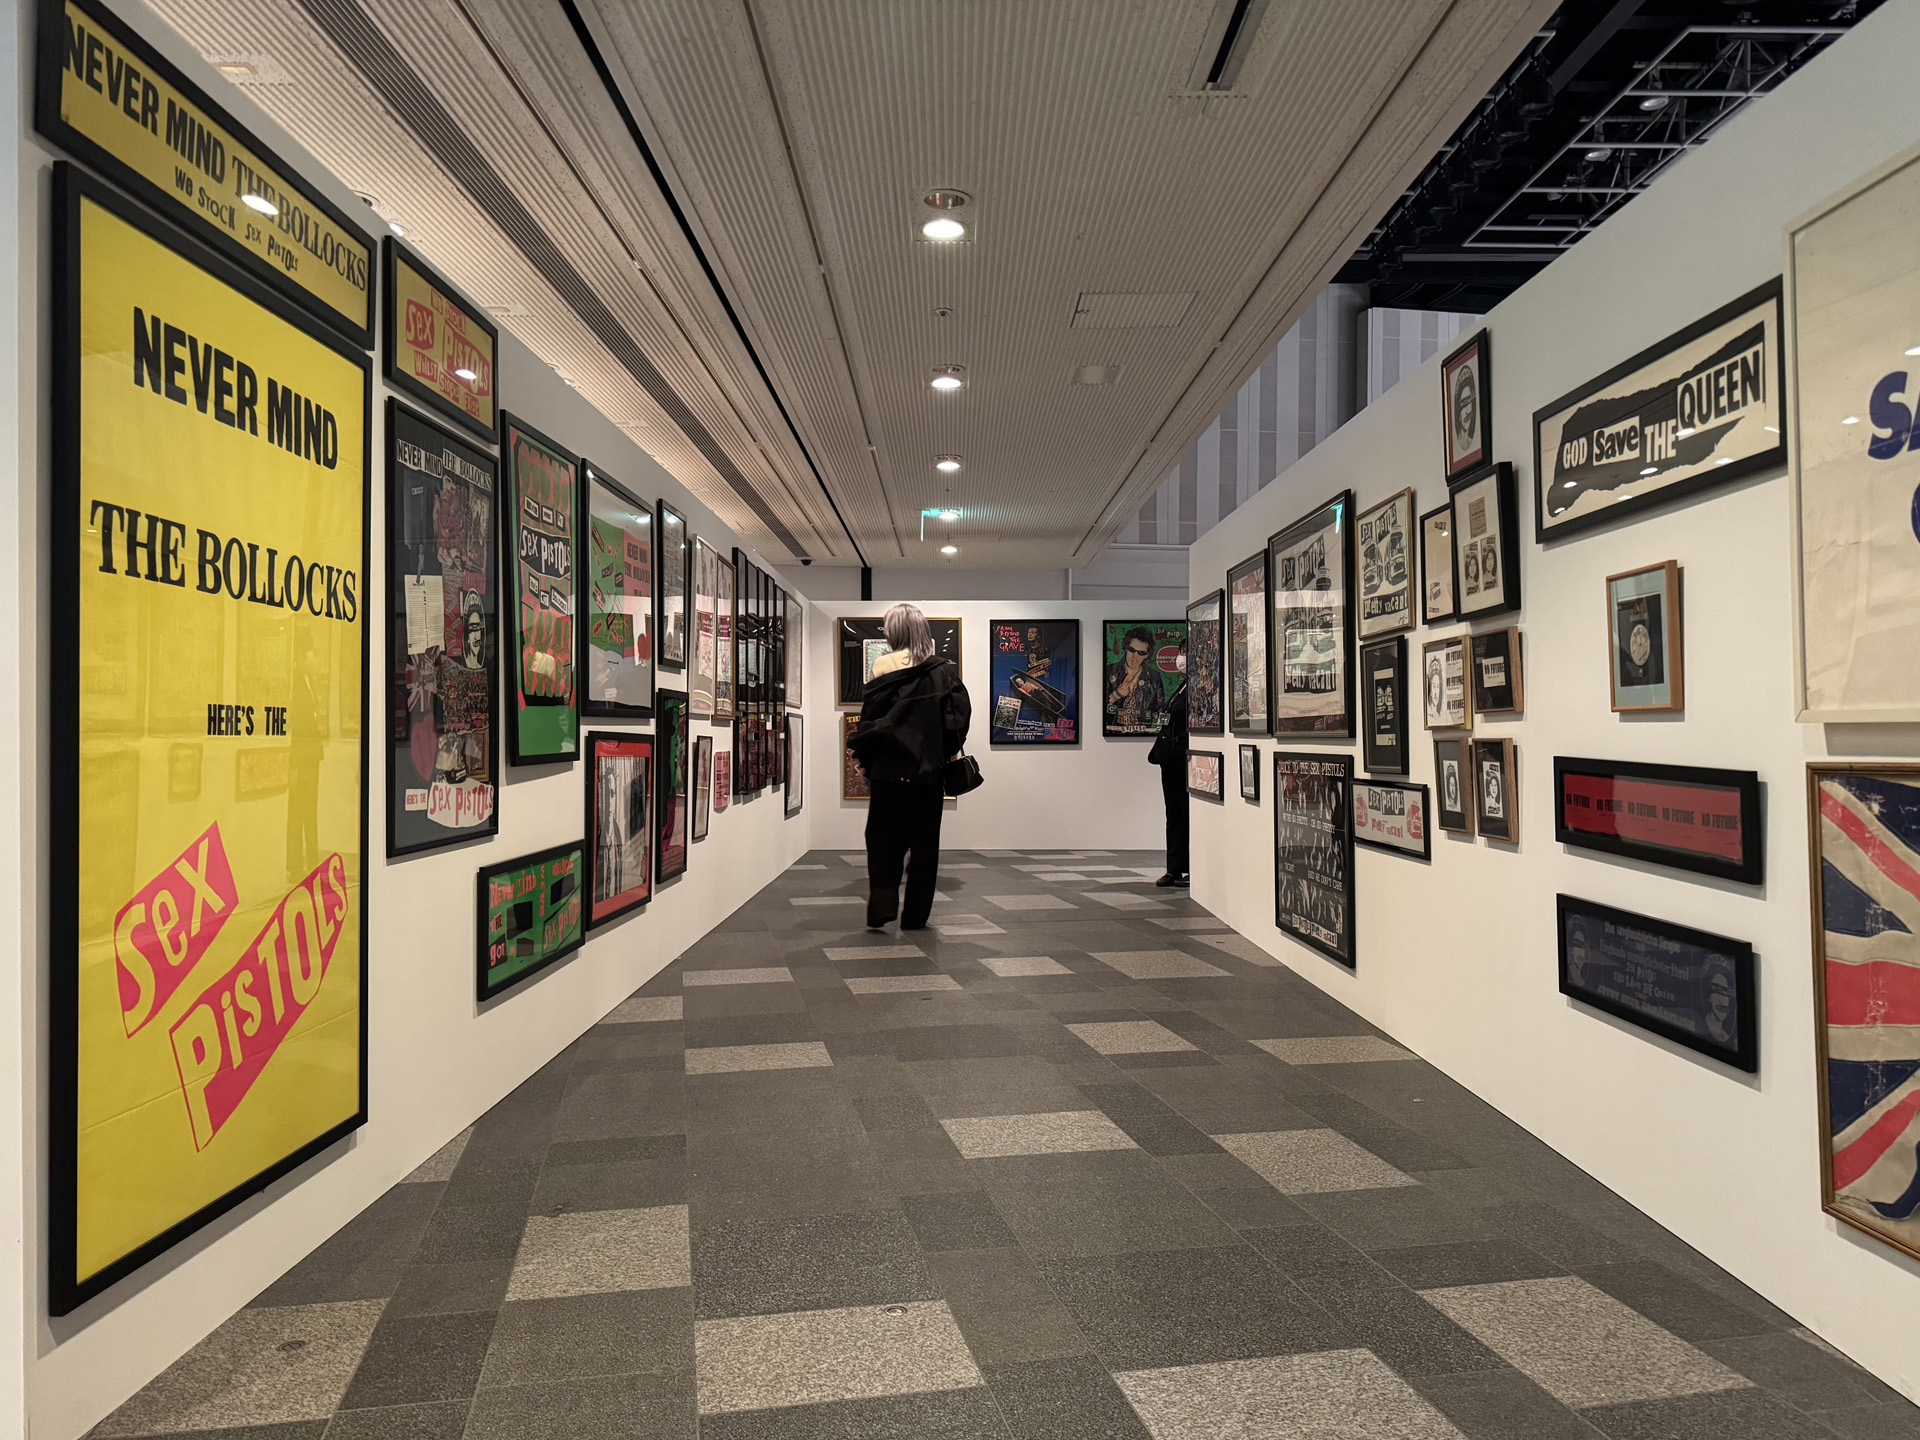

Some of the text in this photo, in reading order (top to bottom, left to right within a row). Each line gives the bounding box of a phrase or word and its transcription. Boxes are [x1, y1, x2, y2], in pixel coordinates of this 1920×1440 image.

[63, 15, 367, 292] NEVER MIND THE BOLLOCKS
[134, 306, 338, 471] NEVER MIND
[1563, 349, 1762, 470] GOD Save THE QUEEN
[398, 440, 422, 469] NEVER
[425, 451, 442, 476] MIND
[460, 460, 491, 490] BOLLOCKS
[90, 499, 186, 588] THE
[195, 528, 357, 623] BOLLOCKS
[999, 642, 1025, 652] GRAVE
[207, 703, 287, 737] HERE'S THE
[1310, 762, 1320, 775] SEX
[1321, 762, 1345, 778] PISTOLS
[1573, 793, 1591, 809] FUTURE
[1712, 814, 1738, 830] FUTURE
[115, 836, 226, 1036] SeX
